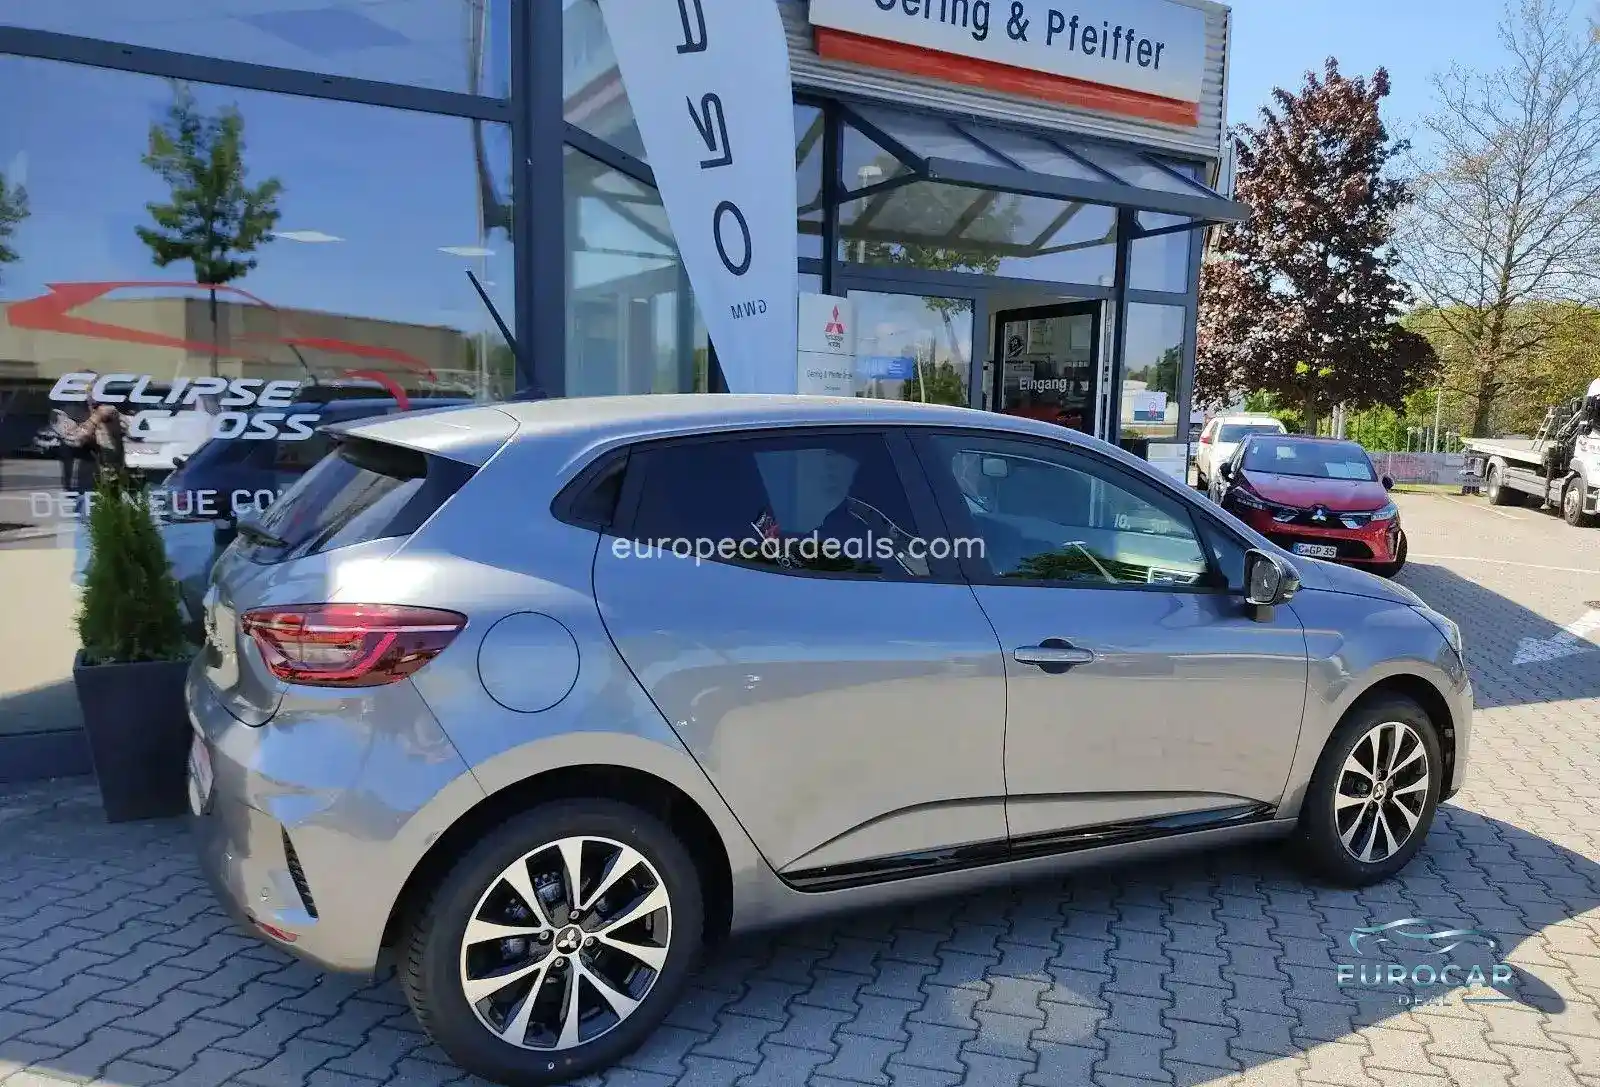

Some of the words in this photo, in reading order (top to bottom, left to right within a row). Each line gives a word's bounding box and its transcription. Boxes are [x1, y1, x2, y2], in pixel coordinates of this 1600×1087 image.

[874, 0, 990, 41] ering
[1006, 1, 1029, 42] &
[1046, 9, 1165, 69] Pfeiffer
[49, 373, 301, 408] ECLIPSE
[1019, 377, 1067, 393] Eingang
[129, 409, 321, 441] COSS
